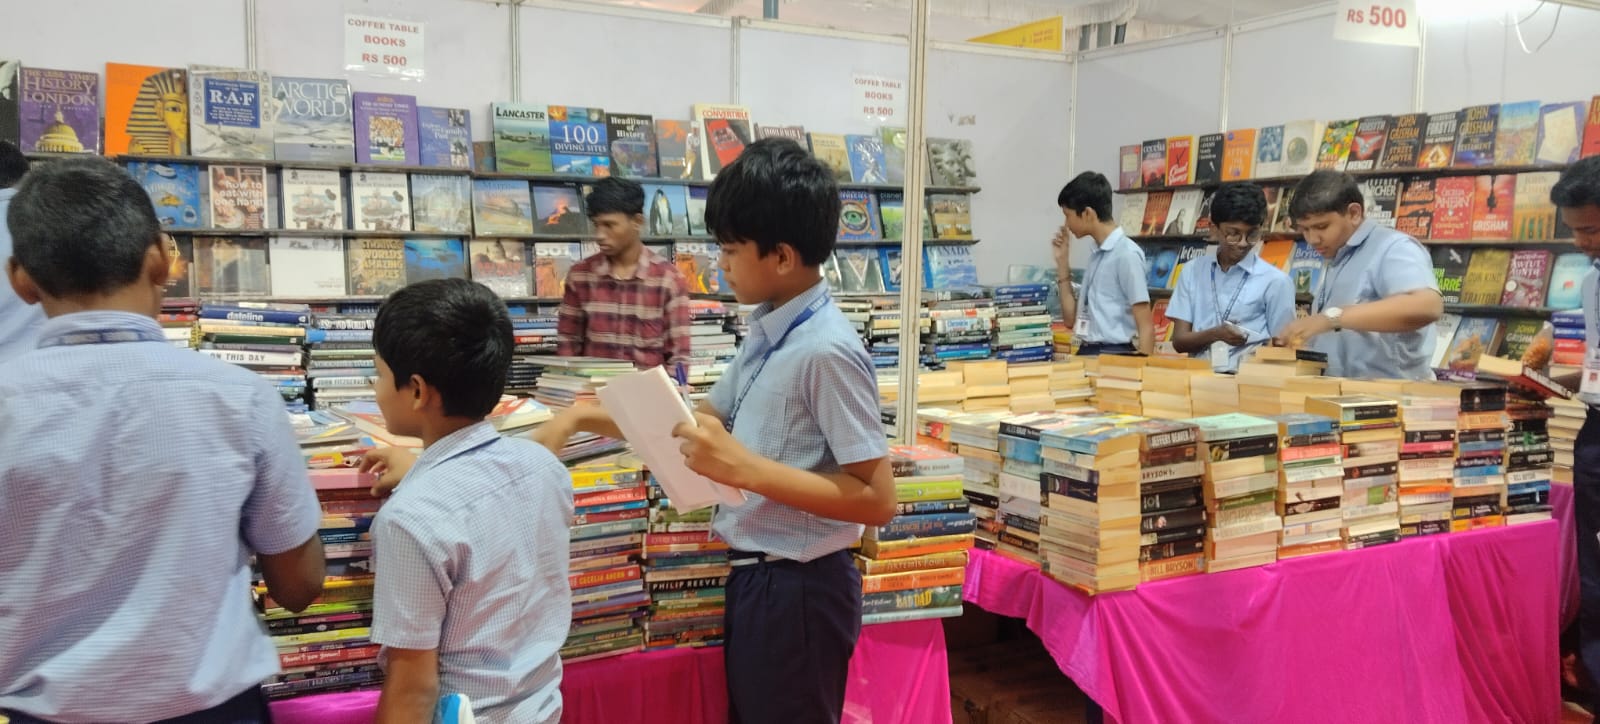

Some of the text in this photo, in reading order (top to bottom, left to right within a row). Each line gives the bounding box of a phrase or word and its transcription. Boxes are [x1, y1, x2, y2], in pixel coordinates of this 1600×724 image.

[1347, 6, 1407, 29] RS 500
[347, 18, 419, 34] COFFEE TABLE
[364, 35, 406, 47] BOOKS
[362, 53, 407, 66] RS 500
[24, 76, 96, 95] HISTORY
[855, 78, 902, 89] COFFEE TABLE
[275, 82, 343, 99] ARCTIC
[865, 91, 893, 100] BOOKS
[24, 91, 96, 106] LONDON
[863, 107, 894, 116] RS 500
[1467, 106, 1489, 119] JOHN
[611, 117, 649, 126] Headlines
[1398, 115, 1416, 127] JOHN
[1391, 128, 1420, 139] GRISHAM
[1427, 120, 1457, 135] FORSYTH
[1460, 121, 1494, 135] GRISHAM
[562, 124, 599, 144] 100
[616, 130, 645, 139] History
[555, 143, 607, 153] DIVING SITES
[225, 181, 249, 190] how
[219, 189, 263, 197] eat with
[237, 197, 264, 207] hand
[1473, 221, 1508, 231] GRISHAM
[536, 246, 569, 256] 501
[1463, 292, 1498, 304] TRAITOR
[227, 312, 264, 322] dateline
[1515, 324, 1536, 333] JOHN
[1506, 333, 1534, 343] GRISHA
[210, 353, 222, 361] ON
[226, 353, 245, 361] THIS
[1151, 430, 1189, 448] JEFFERY DEAVER
[888, 558, 945, 570] ARTEMIS FOWL
[1165, 560, 1194, 573] BRYSON
[578, 572, 625, 585] CECELIA AHERN
[652, 578, 716, 590] PHILIP REEVE
[896, 590, 932, 608] BAD DAD
